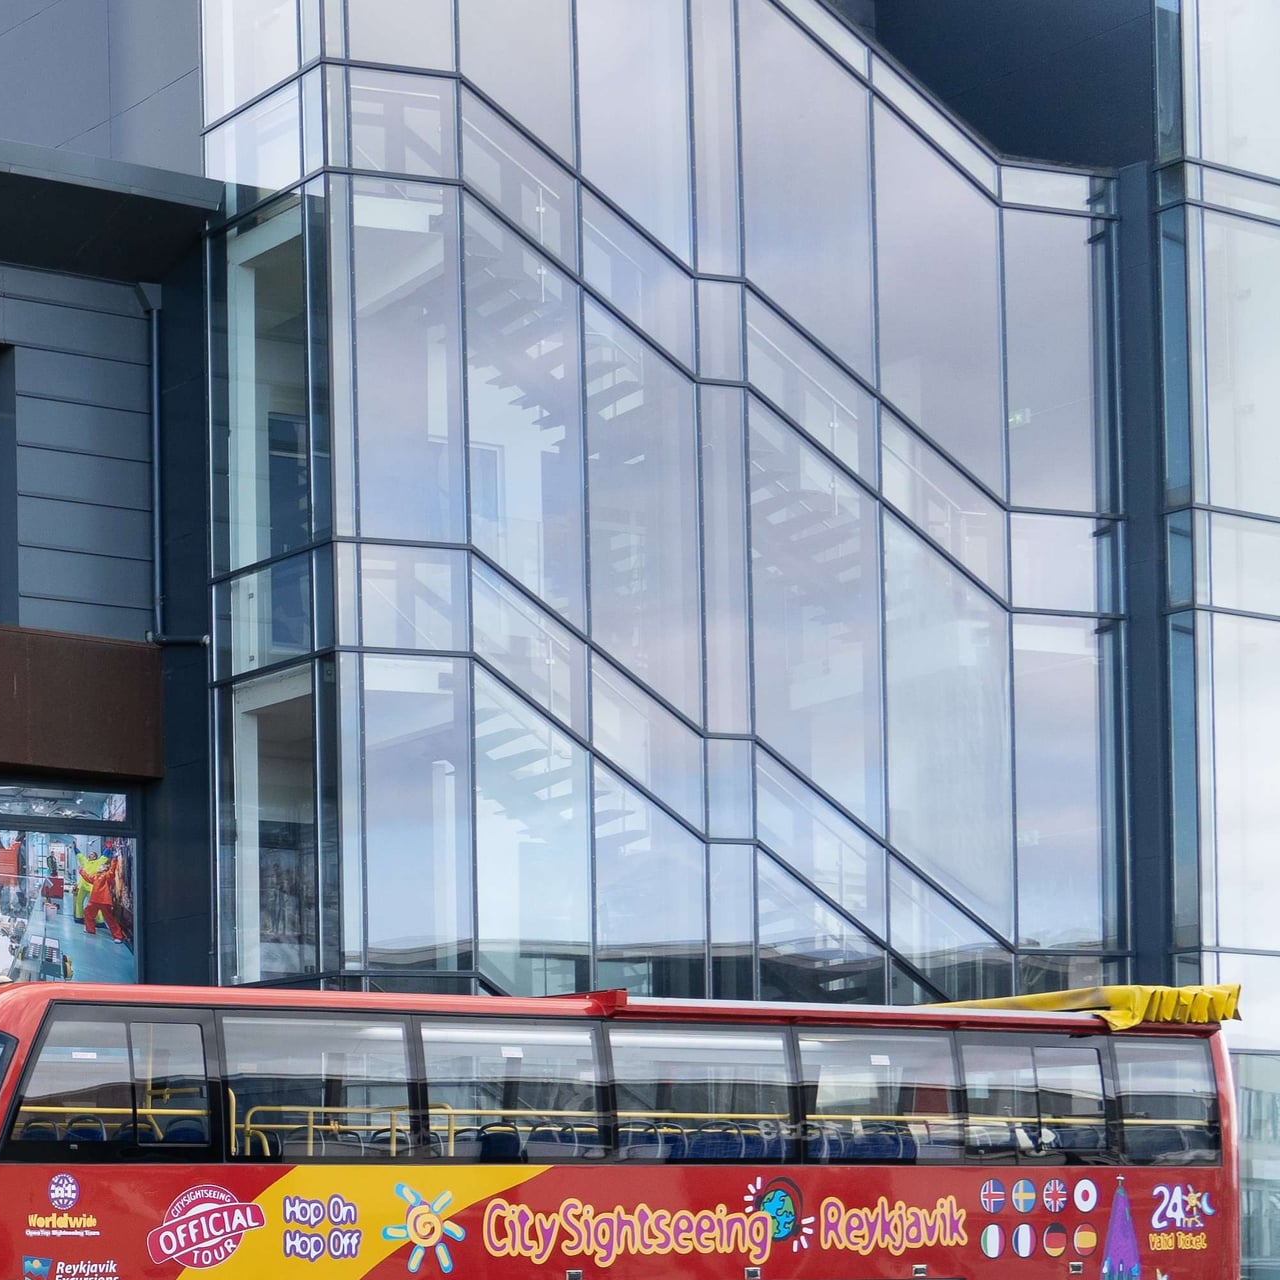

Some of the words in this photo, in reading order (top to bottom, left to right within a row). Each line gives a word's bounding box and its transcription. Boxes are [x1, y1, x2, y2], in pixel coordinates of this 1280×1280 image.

[28, 1212, 97, 1228] Worldwide
[284, 1196, 323, 1227] Hop
[328, 1195, 358, 1224] On
[1151, 1184, 1184, 1230] 24
[159, 1206, 260, 1255] OFFICIAL
[819, 1195, 969, 1257] Reykjavik
[192, 1238, 237, 1265] TOUR
[284, 1230, 324, 1261] Hop
[328, 1228, 362, 1257] Off
[56, 1260, 118, 1278] Reykjavik
